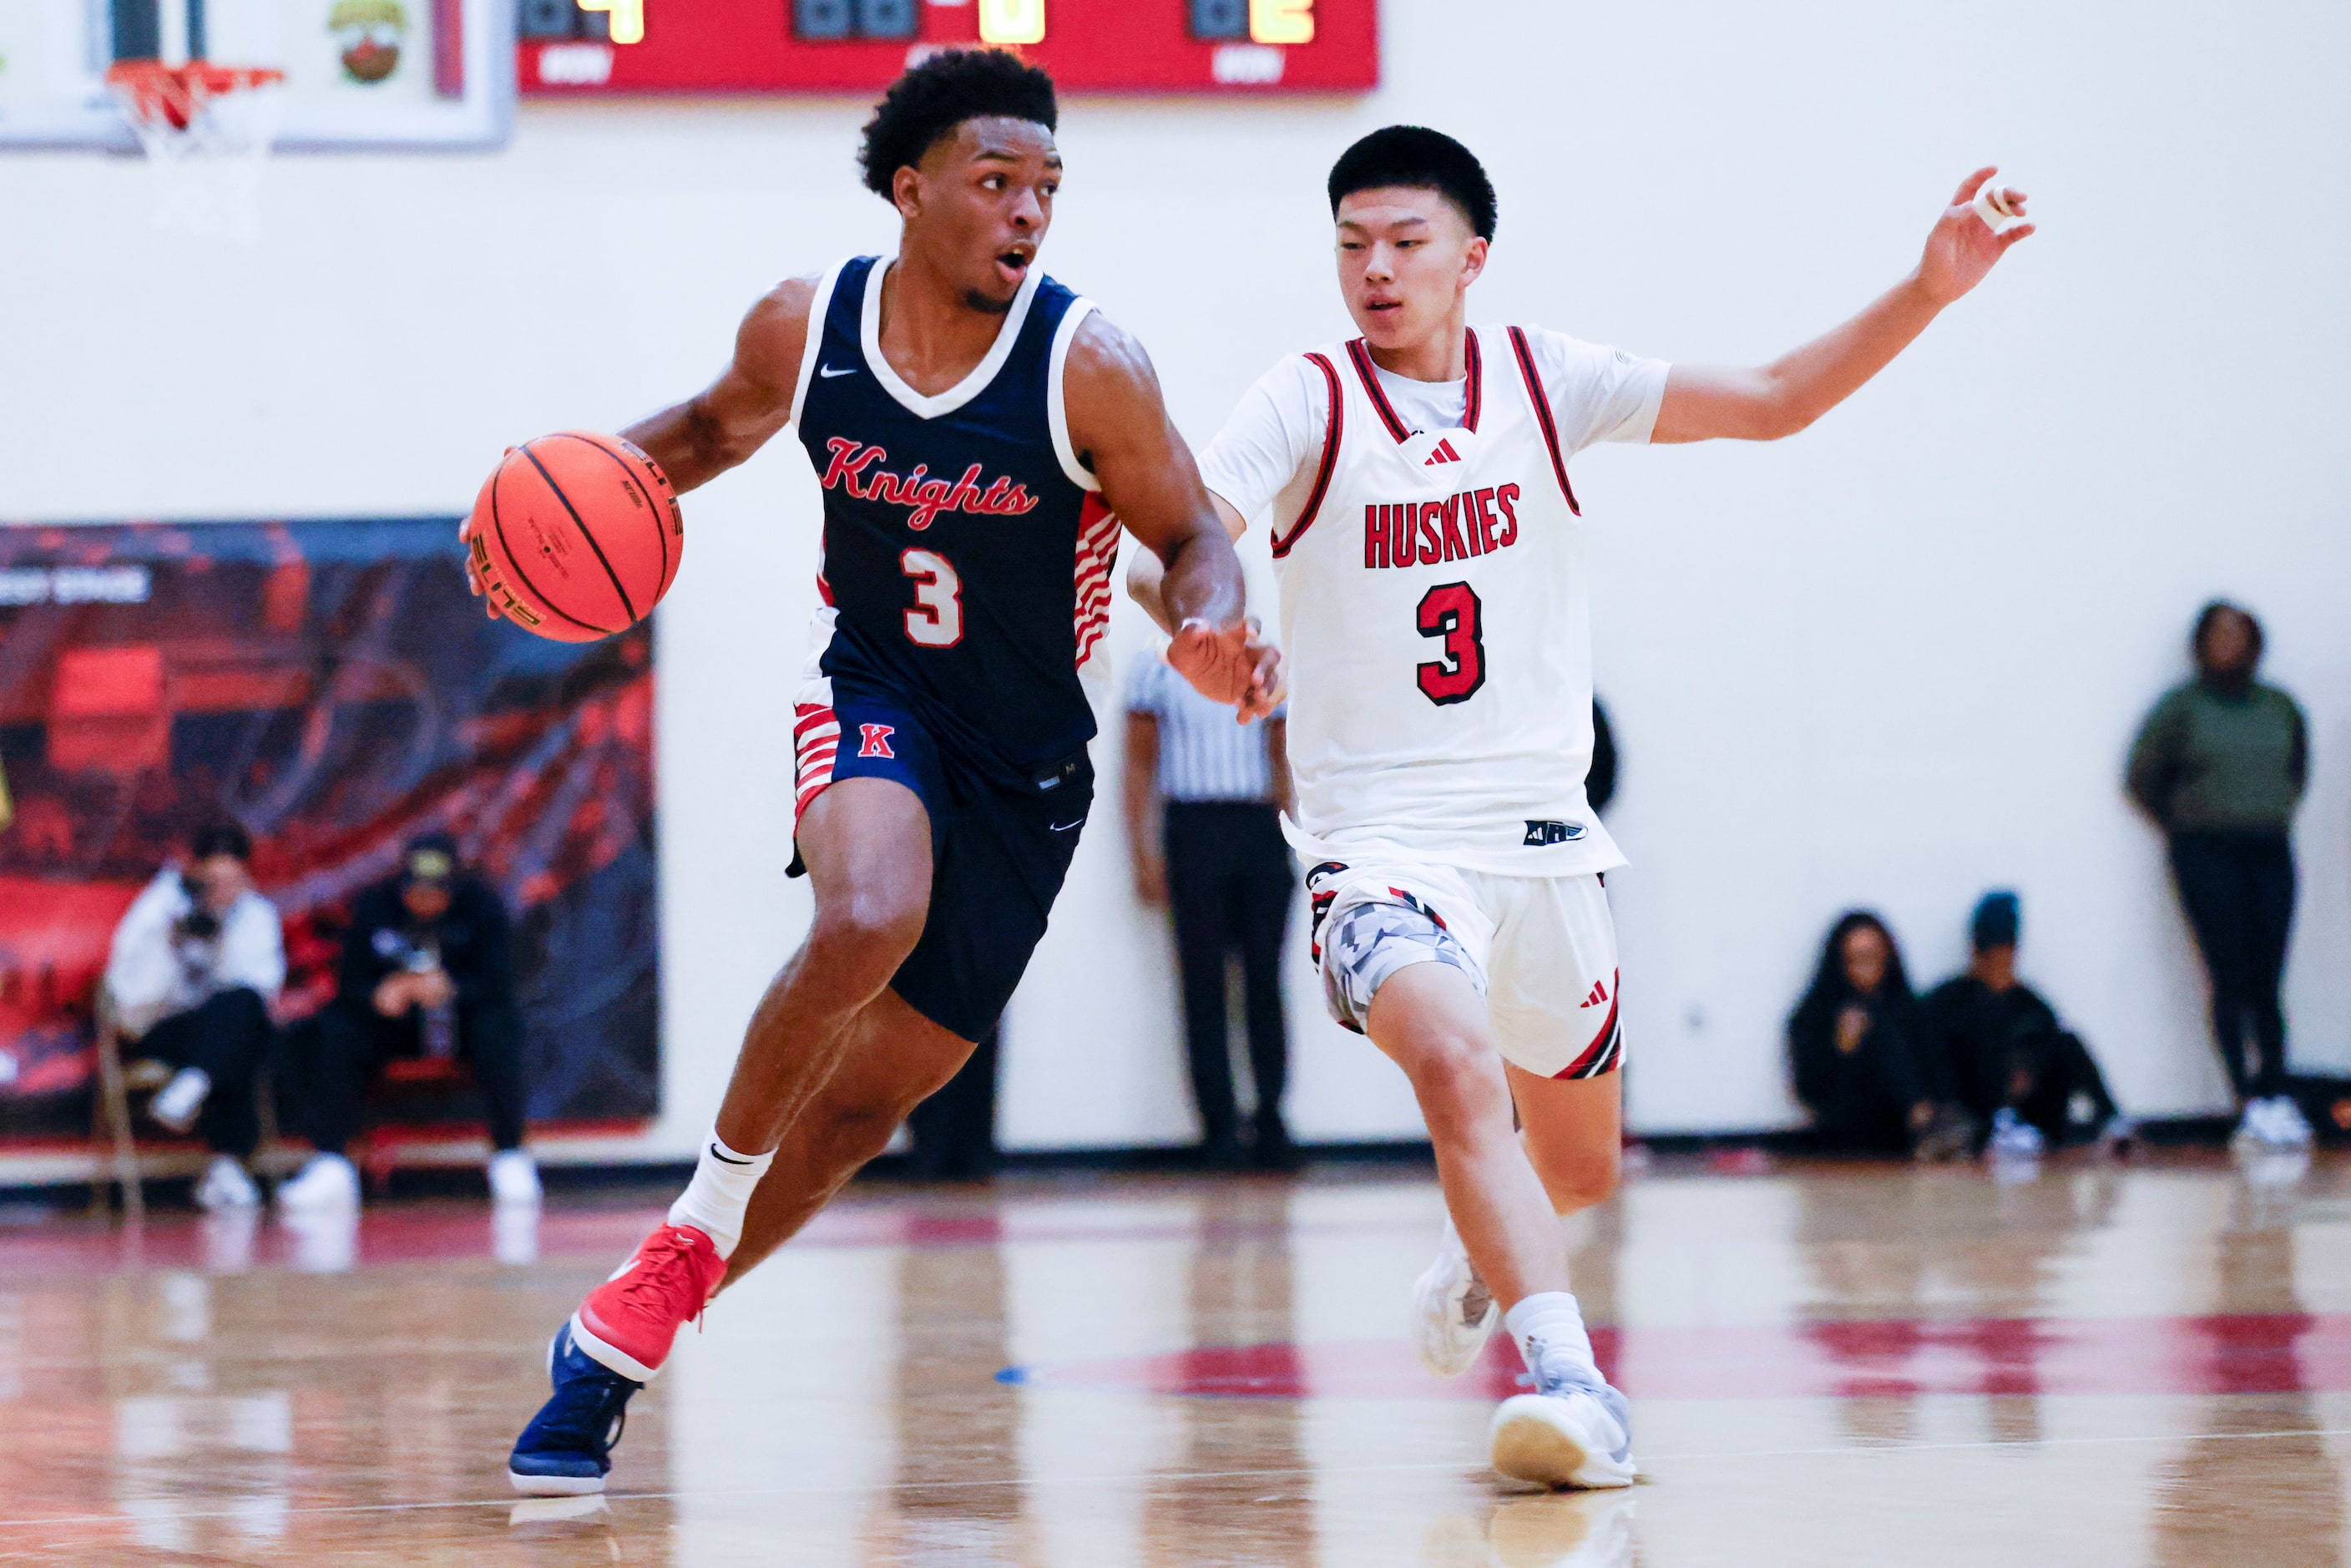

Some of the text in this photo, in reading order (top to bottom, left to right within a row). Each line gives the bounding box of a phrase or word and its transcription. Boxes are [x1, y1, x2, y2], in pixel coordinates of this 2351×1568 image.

[818, 436, 1039, 531] Knights
[1365, 483, 1519, 569] HUSKIES
[899, 546, 964, 649] 3
[1416, 580, 1485, 706] 3
[857, 723, 895, 759] K
